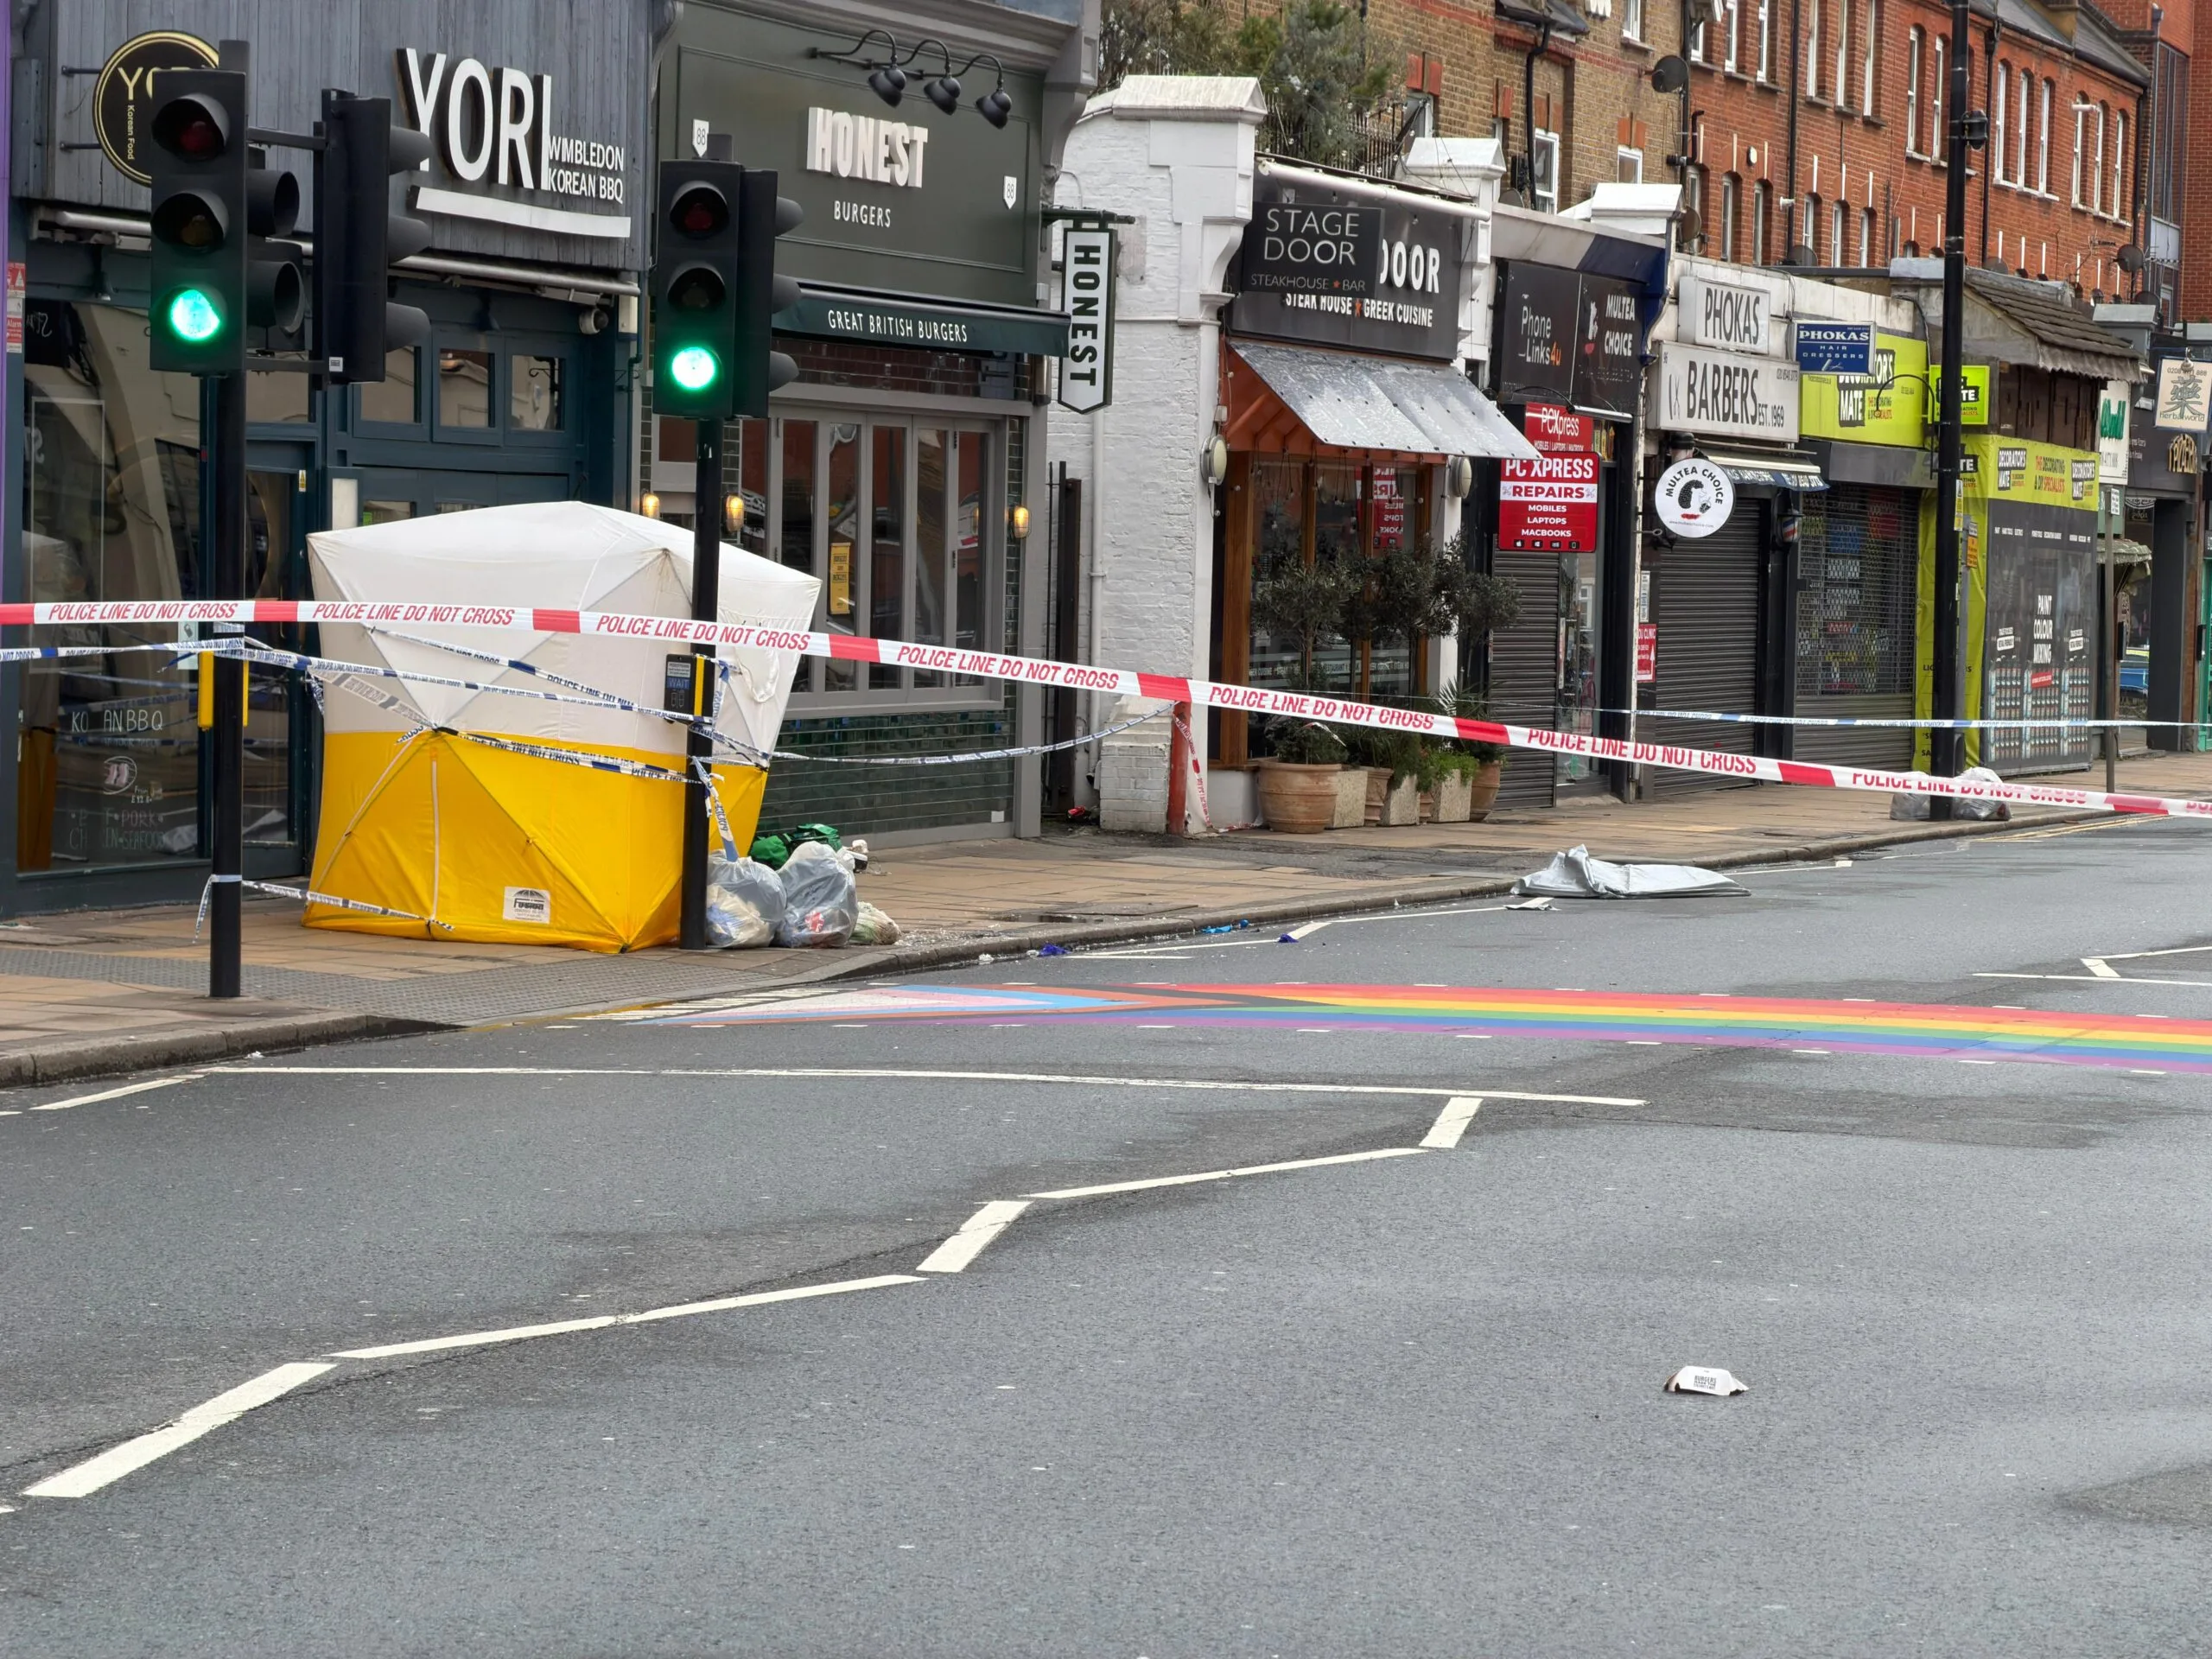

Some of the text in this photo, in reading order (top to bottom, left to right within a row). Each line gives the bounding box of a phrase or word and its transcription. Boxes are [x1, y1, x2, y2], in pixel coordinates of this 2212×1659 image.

[127, 105, 136, 136] Korean
[403, 48, 551, 190] YORI
[696, 127, 706, 146] 88
[806, 106, 928, 188] HONEST
[549, 135, 624, 171] WIMBLEDON
[548, 168, 623, 204] KOREAN BBQ
[1006, 183, 1014, 199] 88
[834, 200, 891, 228] BURGERS
[1266, 208, 1359, 238] STAGE
[1264, 237, 1356, 265] DOOR
[1251, 274, 1366, 292] STEAKHOUSE BAR
[1070, 245, 1101, 386] HONEST
[1285, 293, 1433, 327] STEAK HOUSE GREEK CUISINE
[1521, 305, 1552, 339] Phone
[1605, 294, 1636, 321] MULTEA
[1705, 287, 1760, 345] PHOKAS
[828, 309, 967, 343] GREAT BRITISH BURGERS
[1799, 331, 1869, 340] PHOKAS
[1605, 330, 1633, 357] CHOICE
[1687, 360, 1784, 428] BARBERS EST. 1969
[1840, 390, 1863, 421] MATE
[1961, 390, 1976, 400] TE
[1505, 458, 1593, 479] PC XPRESS
[1512, 486, 1585, 499] REPAIRS
[1665, 466, 1698, 498] MULTEA
[1702, 468, 1724, 505] CHOICE
[48, 602, 238, 620] POLICE LINE DO NOT CROSS
[312, 603, 515, 625] POLICE LINE DO NOT CROSS
[2038, 595, 2052, 615] PAINT
[596, 615, 810, 651] POLICE LINE DO NOT CROSS
[2033, 620, 2053, 639] COLOUR
[897, 645, 1119, 690] POLICE LINE DO NOT CROSS
[669, 677, 690, 688] WAIT
[72, 709, 162, 733] KOAN BBQ
[1210, 686, 1434, 730] POLICE LINE DO NOT CROSS
[549, 753, 581, 766] CROSS
[1527, 728, 1757, 775] POLICE LINE DO NOT CROSS
